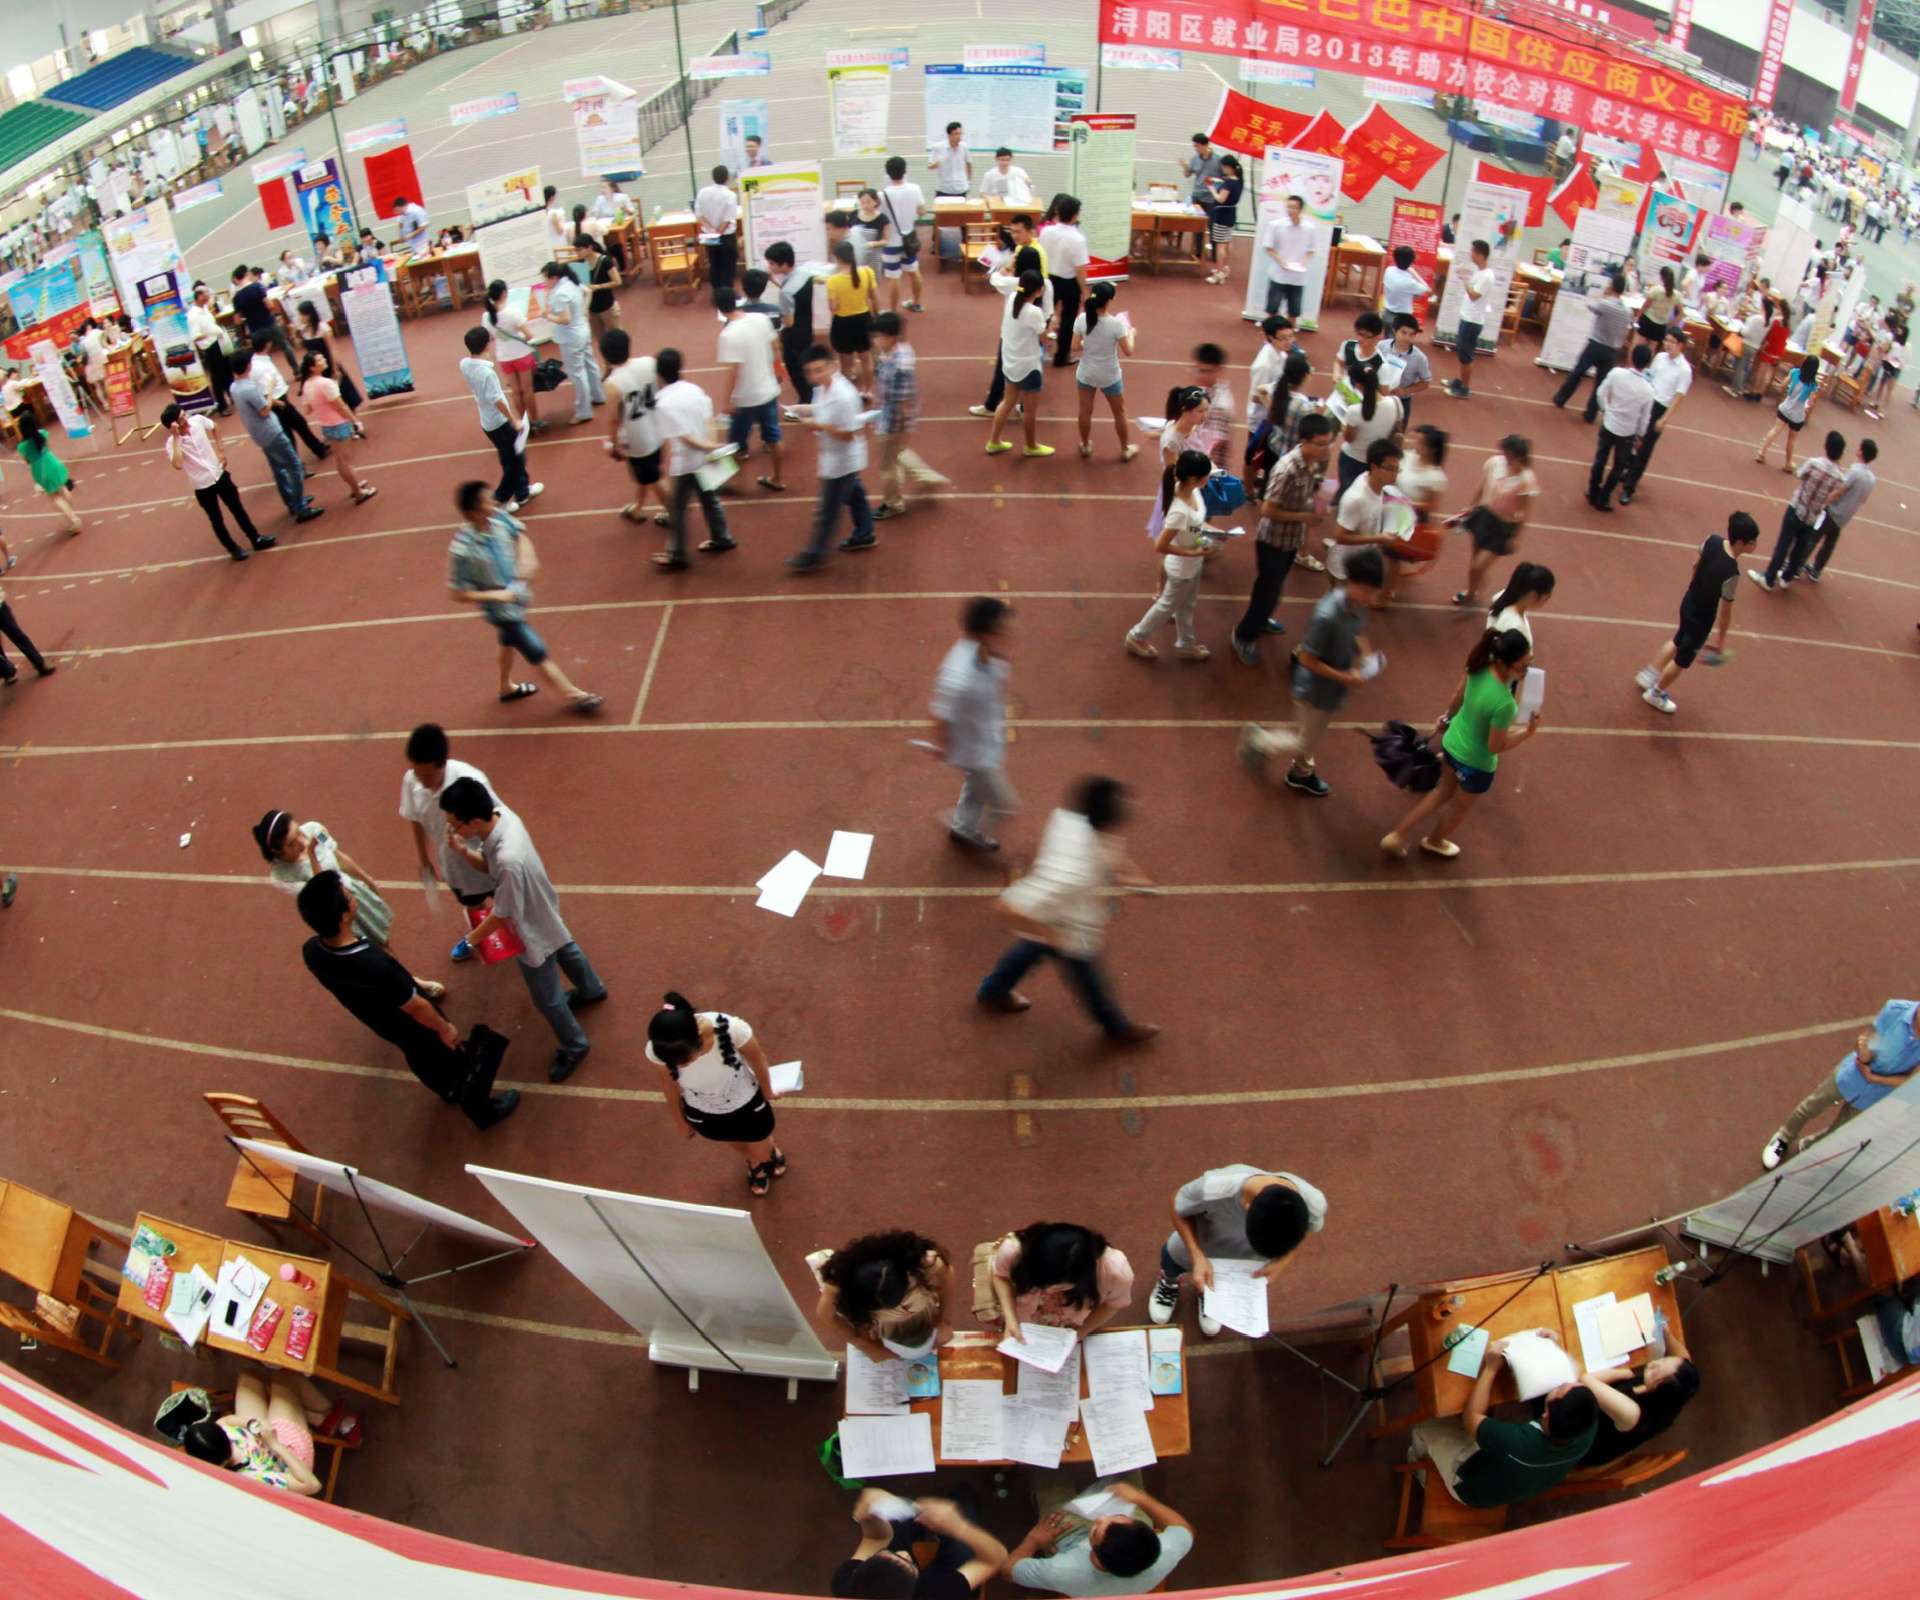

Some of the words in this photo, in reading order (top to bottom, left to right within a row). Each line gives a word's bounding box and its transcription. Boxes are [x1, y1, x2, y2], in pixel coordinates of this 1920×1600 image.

[1590, 96, 1721, 162] 促大学生就业
